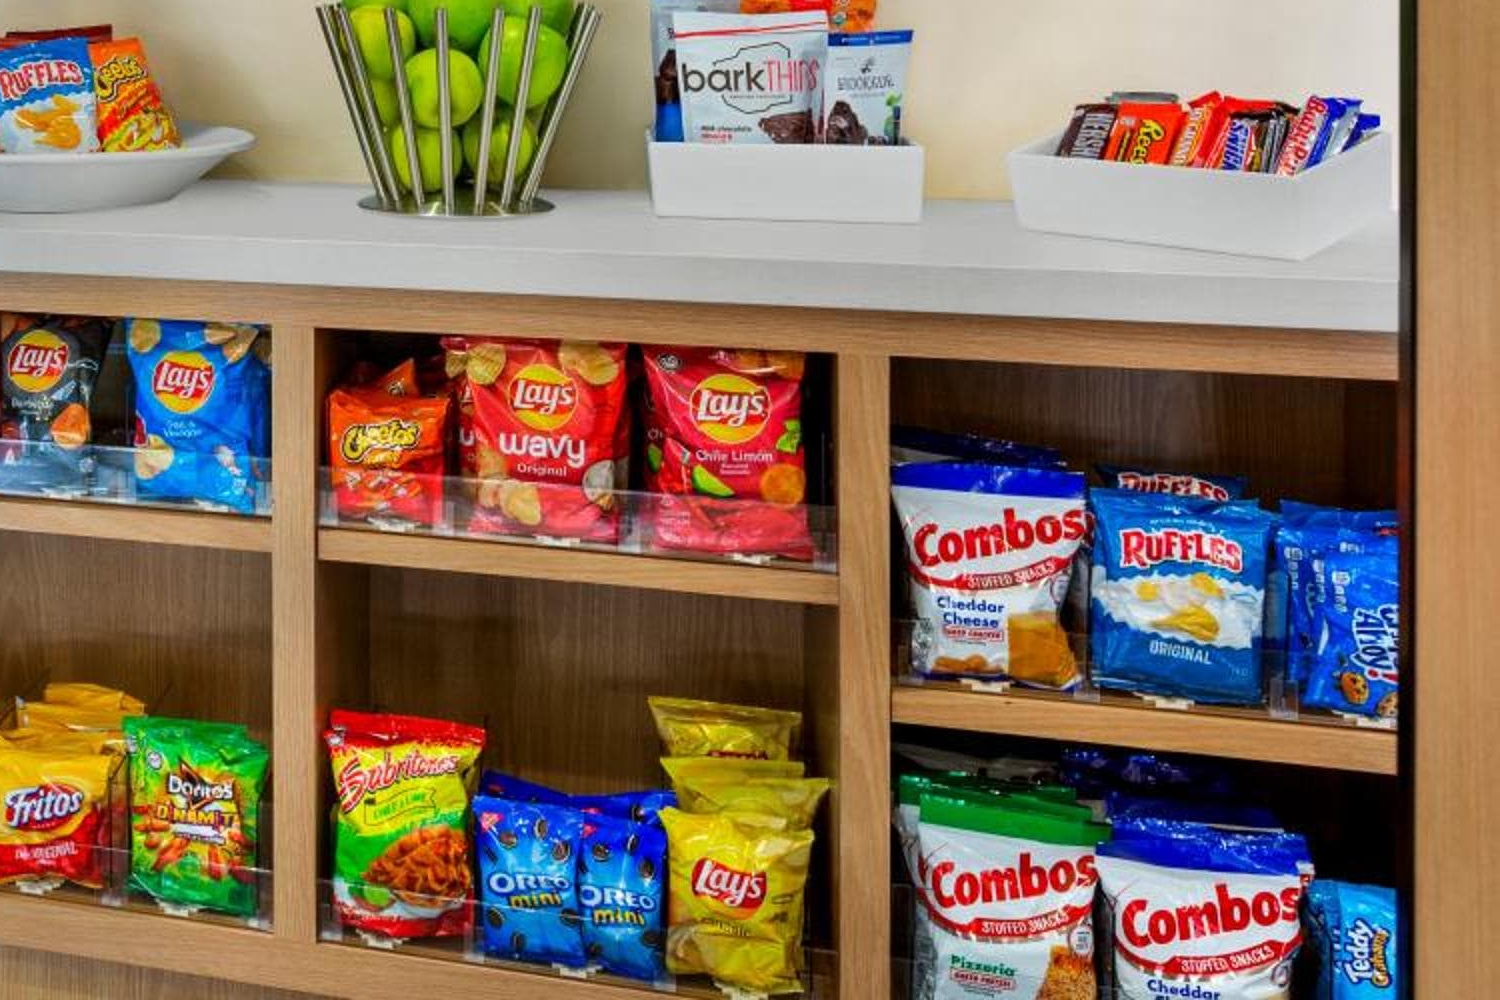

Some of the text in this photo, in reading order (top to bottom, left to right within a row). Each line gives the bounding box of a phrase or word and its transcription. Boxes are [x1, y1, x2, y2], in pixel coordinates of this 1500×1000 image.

[12, 342, 67, 377] Lay's
[154, 360, 214, 400] Lay's
[512, 379, 575, 416] Lay's
[696, 387, 768, 427] Lay's
[500, 431, 586, 468] wavy
[695, 448, 729, 464] Chile
[516, 461, 568, 477] Original
[913, 507, 1087, 568] Combos
[1119, 528, 1243, 573] RUFFLES
[966, 557, 1057, 590] STUFFED SNACKS
[936, 596, 1005, 614] Cheddar
[942, 611, 999, 629] Cheese
[1149, 640, 1212, 665] ORIGINAL
[169, 774, 234, 799] Doritos
[3, 787, 84, 828] Fritos
[487, 872, 571, 894] OREO
[694, 859, 765, 909] Lay's
[930, 851, 1099, 910] Combos
[510, 890, 563, 909] mini
[578, 884, 657, 912] OREO
[593, 907, 645, 927] mini
[981, 909, 1070, 936] STUFFED SNACKS
[1121, 883, 1304, 949] Combos
[949, 952, 1017, 978] Pizzeria
[1180, 944, 1276, 974] STUFFED SNACKS
[1343, 918, 1376, 985] Teddy
[1146, 978, 1222, 1000] Cheddar
